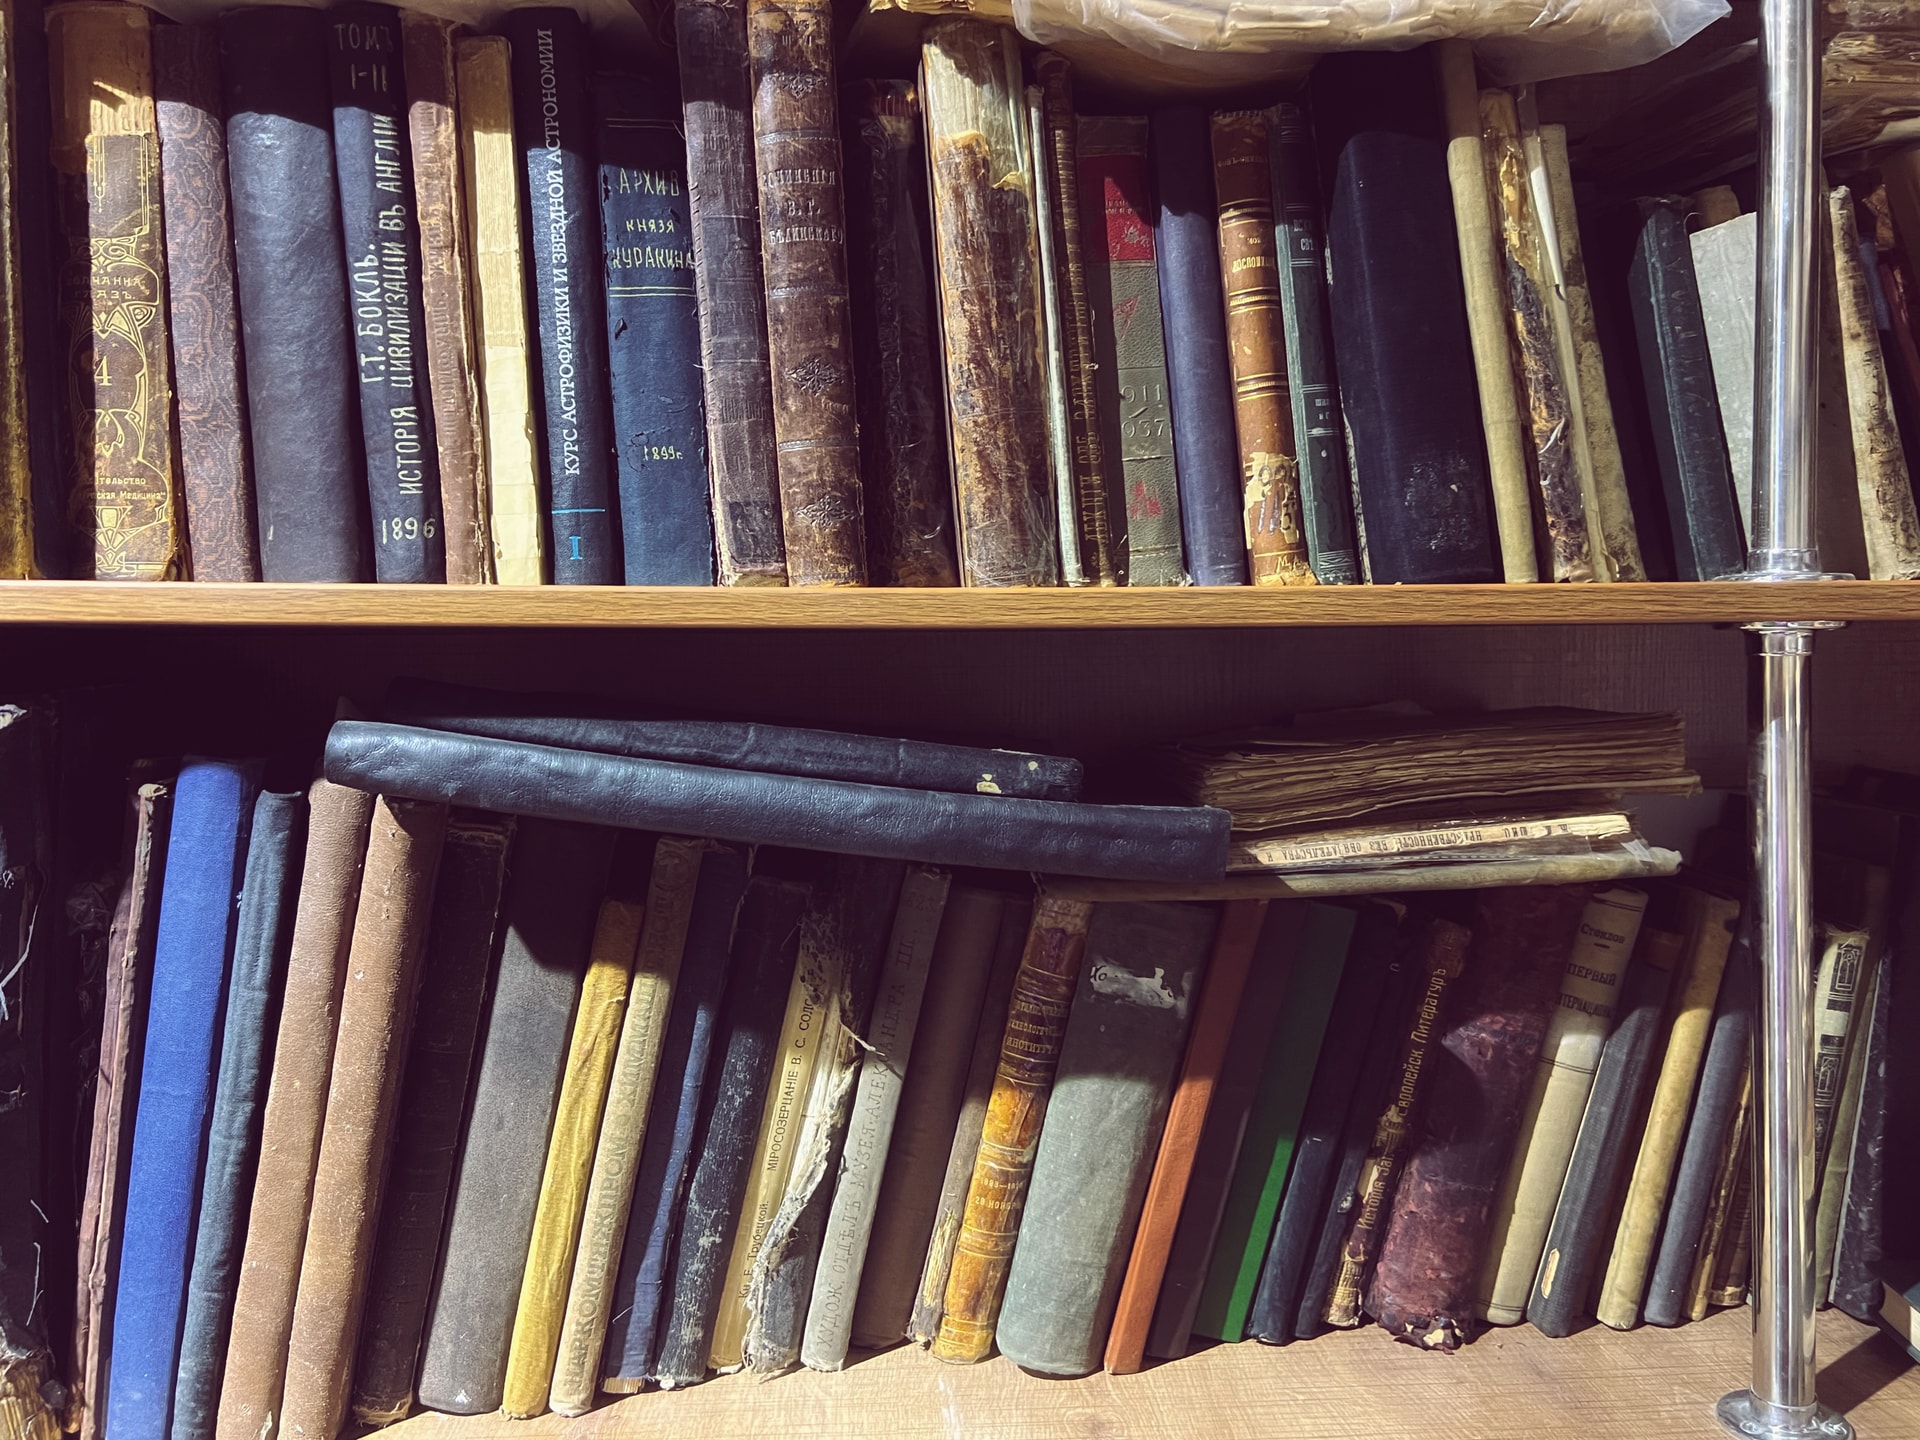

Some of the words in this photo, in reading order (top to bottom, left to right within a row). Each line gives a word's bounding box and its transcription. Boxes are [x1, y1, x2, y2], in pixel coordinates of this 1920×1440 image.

[538, 29, 563, 162] АСТРОНОМИИ
[379, 204, 406, 232] ВЪ
[546, 167, 567, 271] ЗВЕЗДНОЙ
[625, 218, 676, 235] КНЯЗЯ
[611, 247, 696, 271] КУРАКИНА
[554, 273, 568, 287] И
[384, 243, 415, 388] ЦИВИЛИЗАЦІИ
[553, 289, 577, 422] АСТРОФИЗИКИ
[391, 405, 424, 495] ИСТОРІЯ
[562, 425, 580, 475] КУРС
[382, 517, 436, 544] 1896
[1280, 841, 1361, 863] ОБЯАТЕЛЬСТВА
[1567, 963, 1617, 986] ПЕРВЫЙ
[1412, 967, 1447, 1044] Литературъ
[790, 1053, 802, 1065] В.
[793, 1035, 806, 1049] С.
[767, 1069, 798, 1172] МІРОСОЗЕРЦАНІЕ
[817, 1278, 847, 1349] ХУДОЖ.
